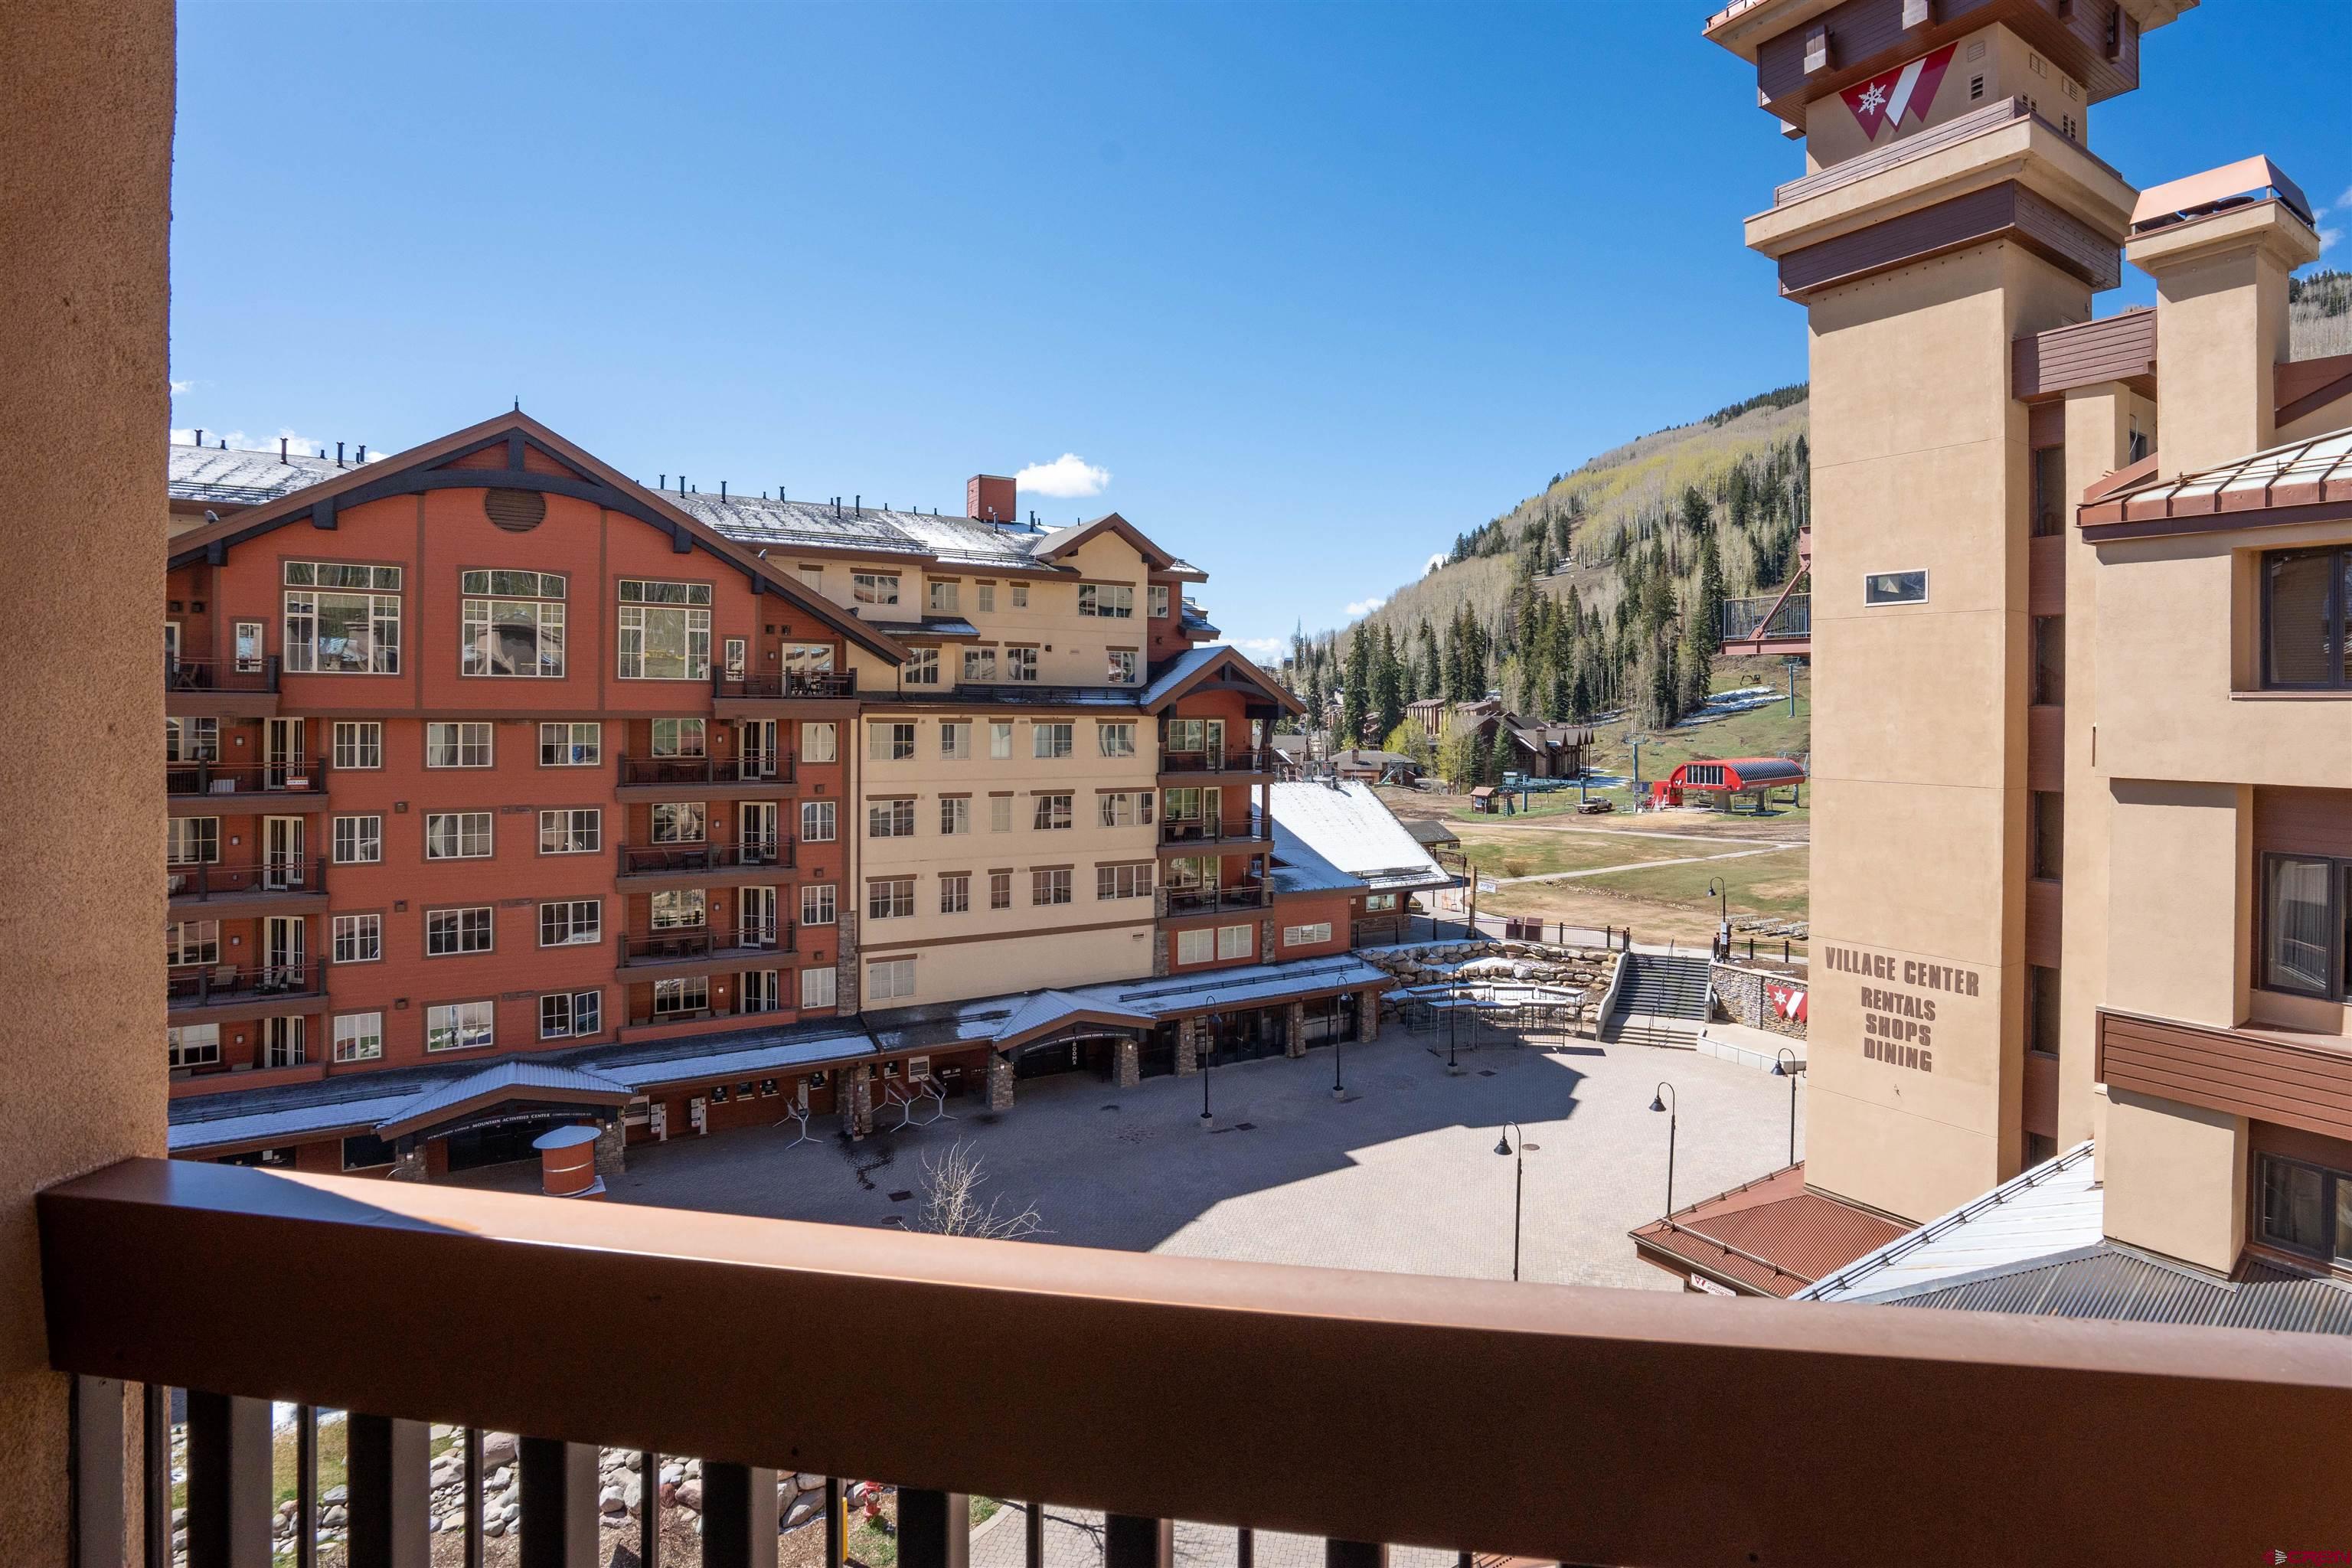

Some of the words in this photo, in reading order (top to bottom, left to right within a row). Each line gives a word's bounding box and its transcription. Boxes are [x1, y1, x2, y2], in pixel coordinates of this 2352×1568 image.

[1825, 946, 1896, 982] VILLAGE
[1904, 960, 1979, 997] CENTER
[1861, 986, 1936, 1021] RENTALS
[1865, 1013, 1931, 1047] SHOPS
[1864, 1037, 1932, 1073] DINING
[472, 1119, 501, 1128] MOUNTAIN
